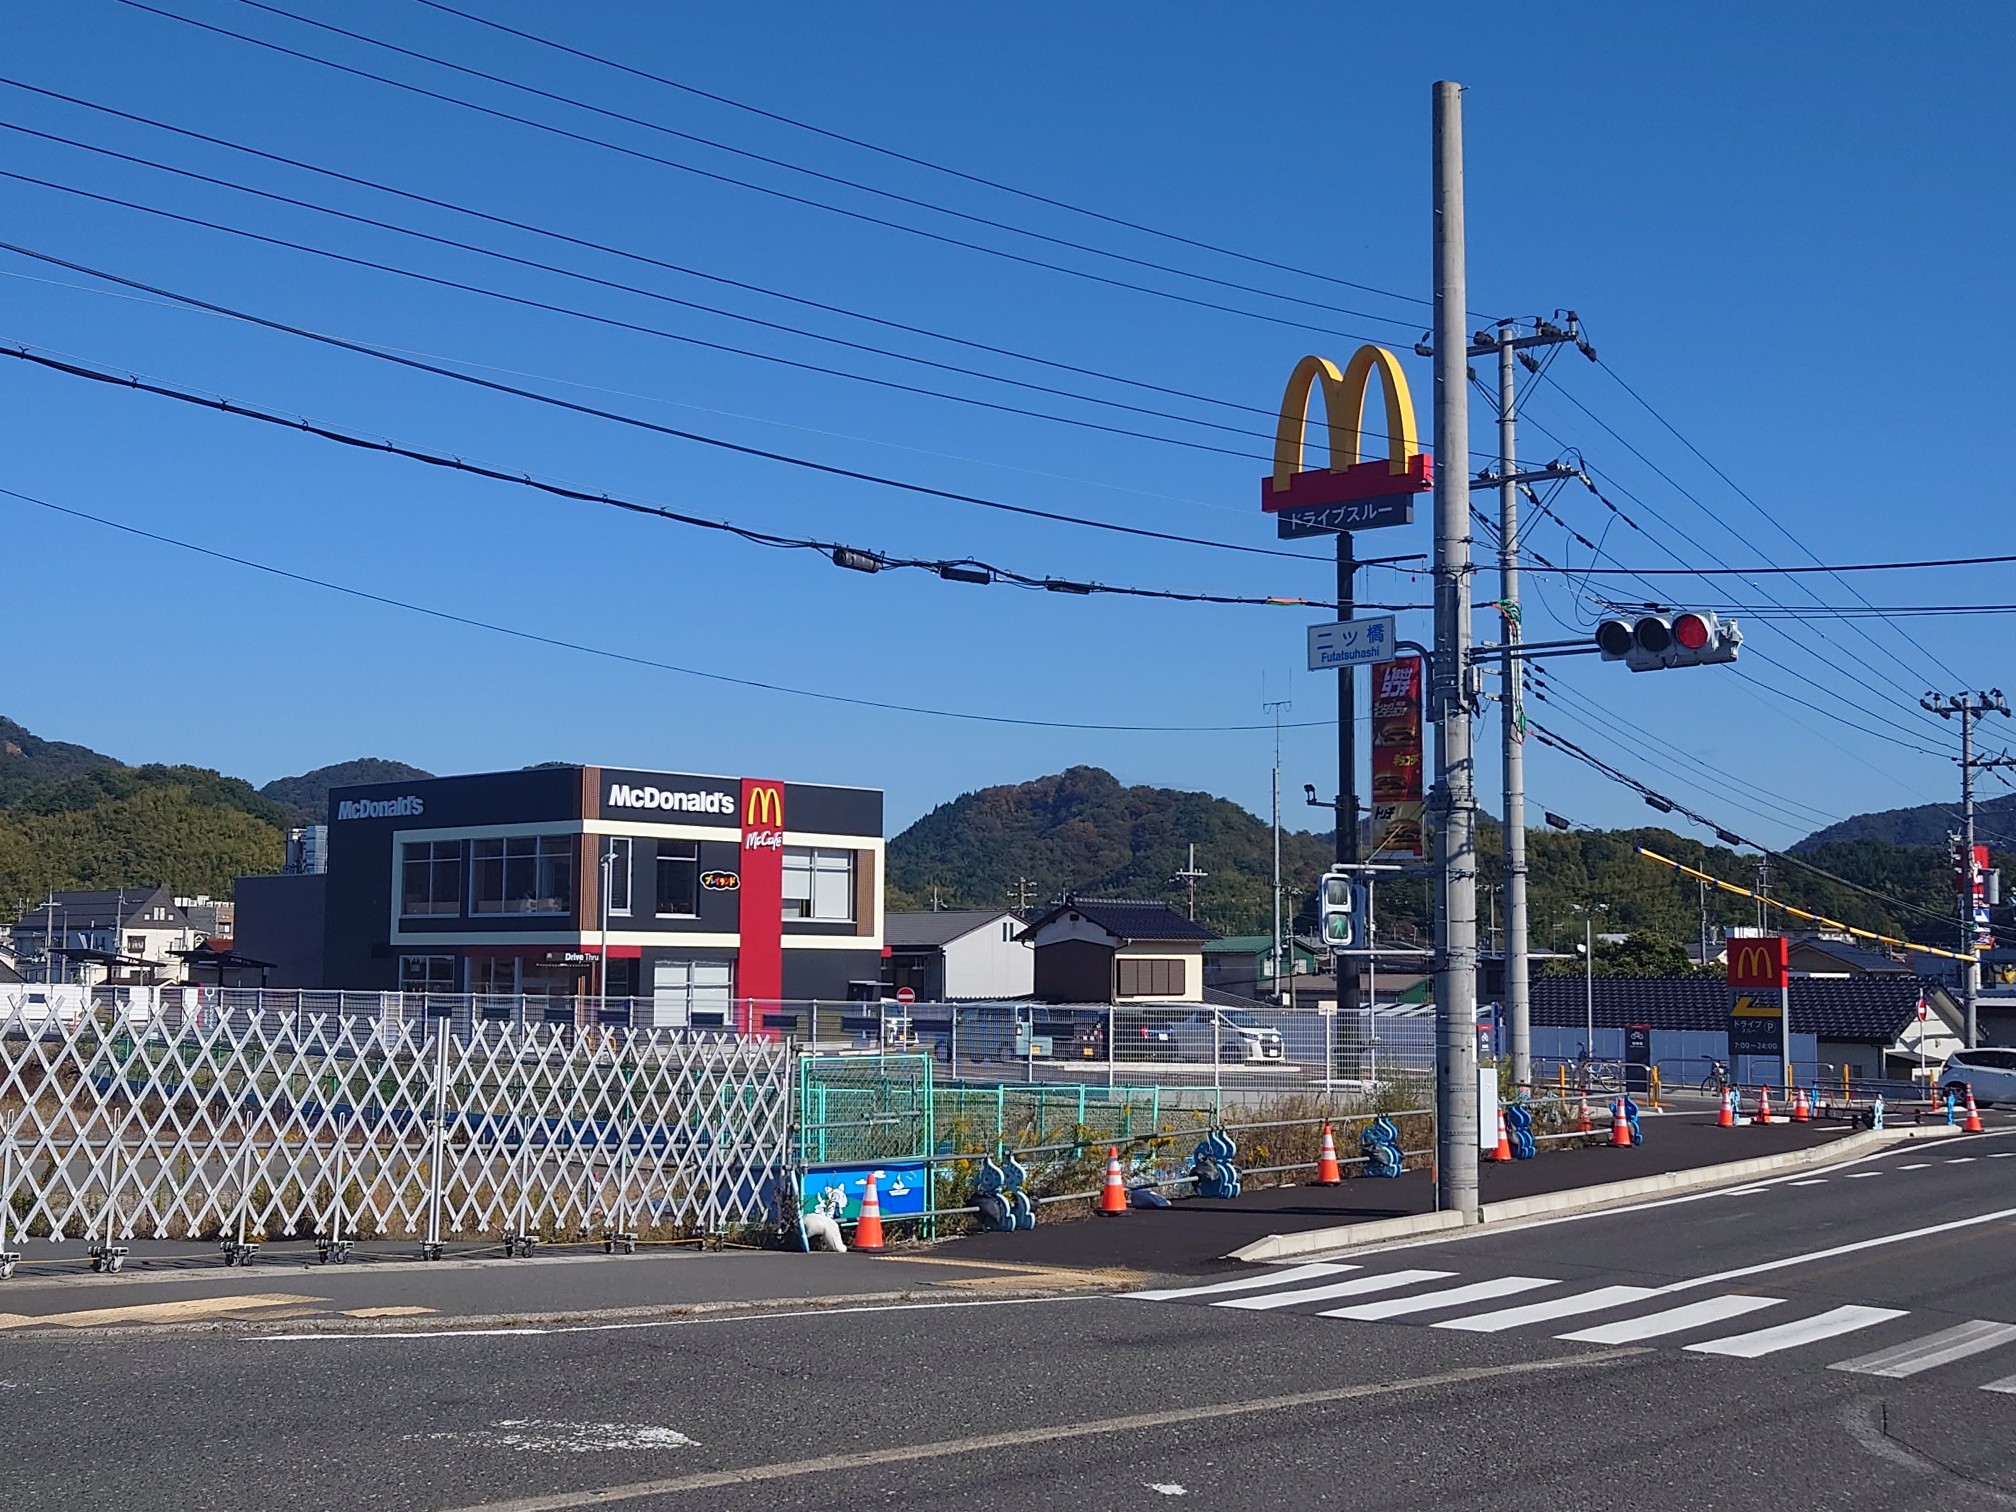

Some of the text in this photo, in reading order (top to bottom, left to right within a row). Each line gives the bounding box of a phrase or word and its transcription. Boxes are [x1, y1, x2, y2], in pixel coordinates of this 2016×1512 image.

[1291, 503, 1393, 531] ドライブスルー
[1321, 645, 1380, 664] Futatsuhashi
[338, 795, 424, 820] McDonald's
[608, 784, 735, 814] McDonald's
[565, 953, 599, 961] Drive Thru
